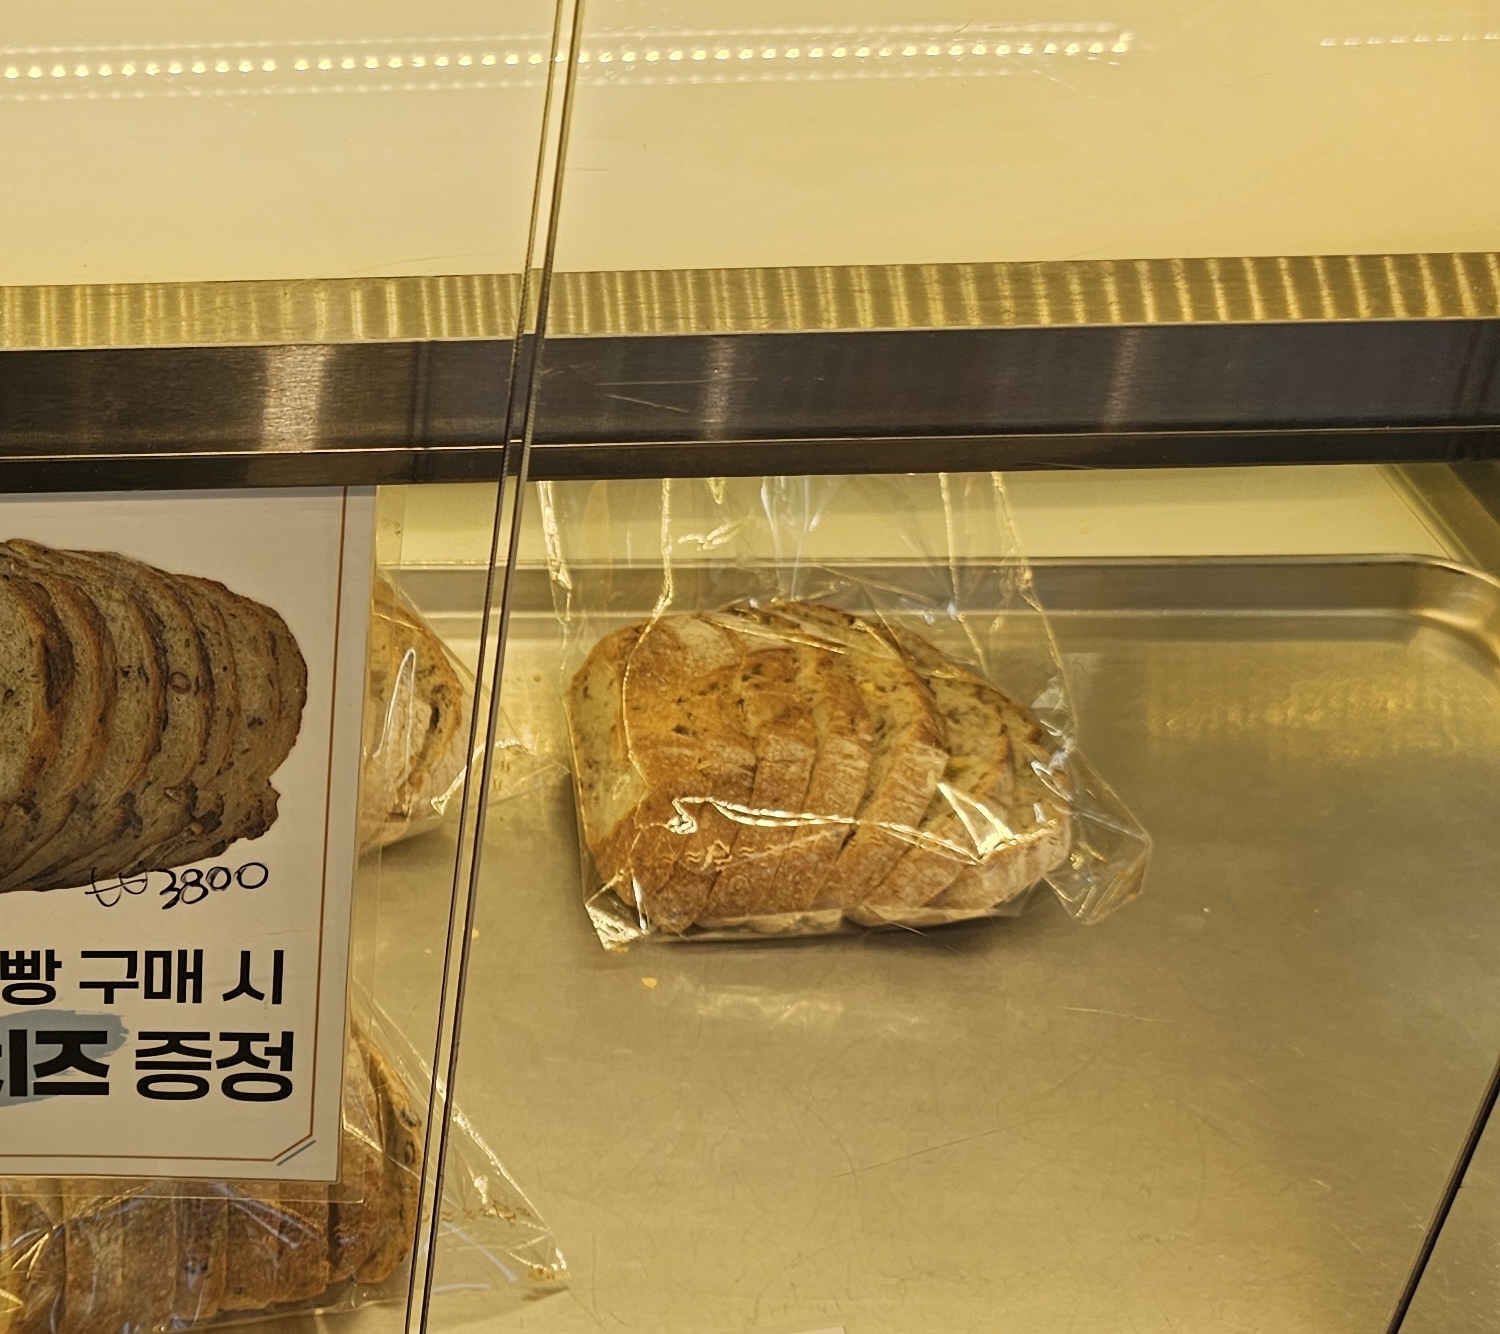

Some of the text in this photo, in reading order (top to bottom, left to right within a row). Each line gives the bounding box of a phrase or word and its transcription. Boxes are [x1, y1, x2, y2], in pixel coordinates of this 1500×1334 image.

[79, 949, 204, 1005] 구매
[222, 949, 284, 1005] 시
[135, 1030, 294, 1101] 증정
